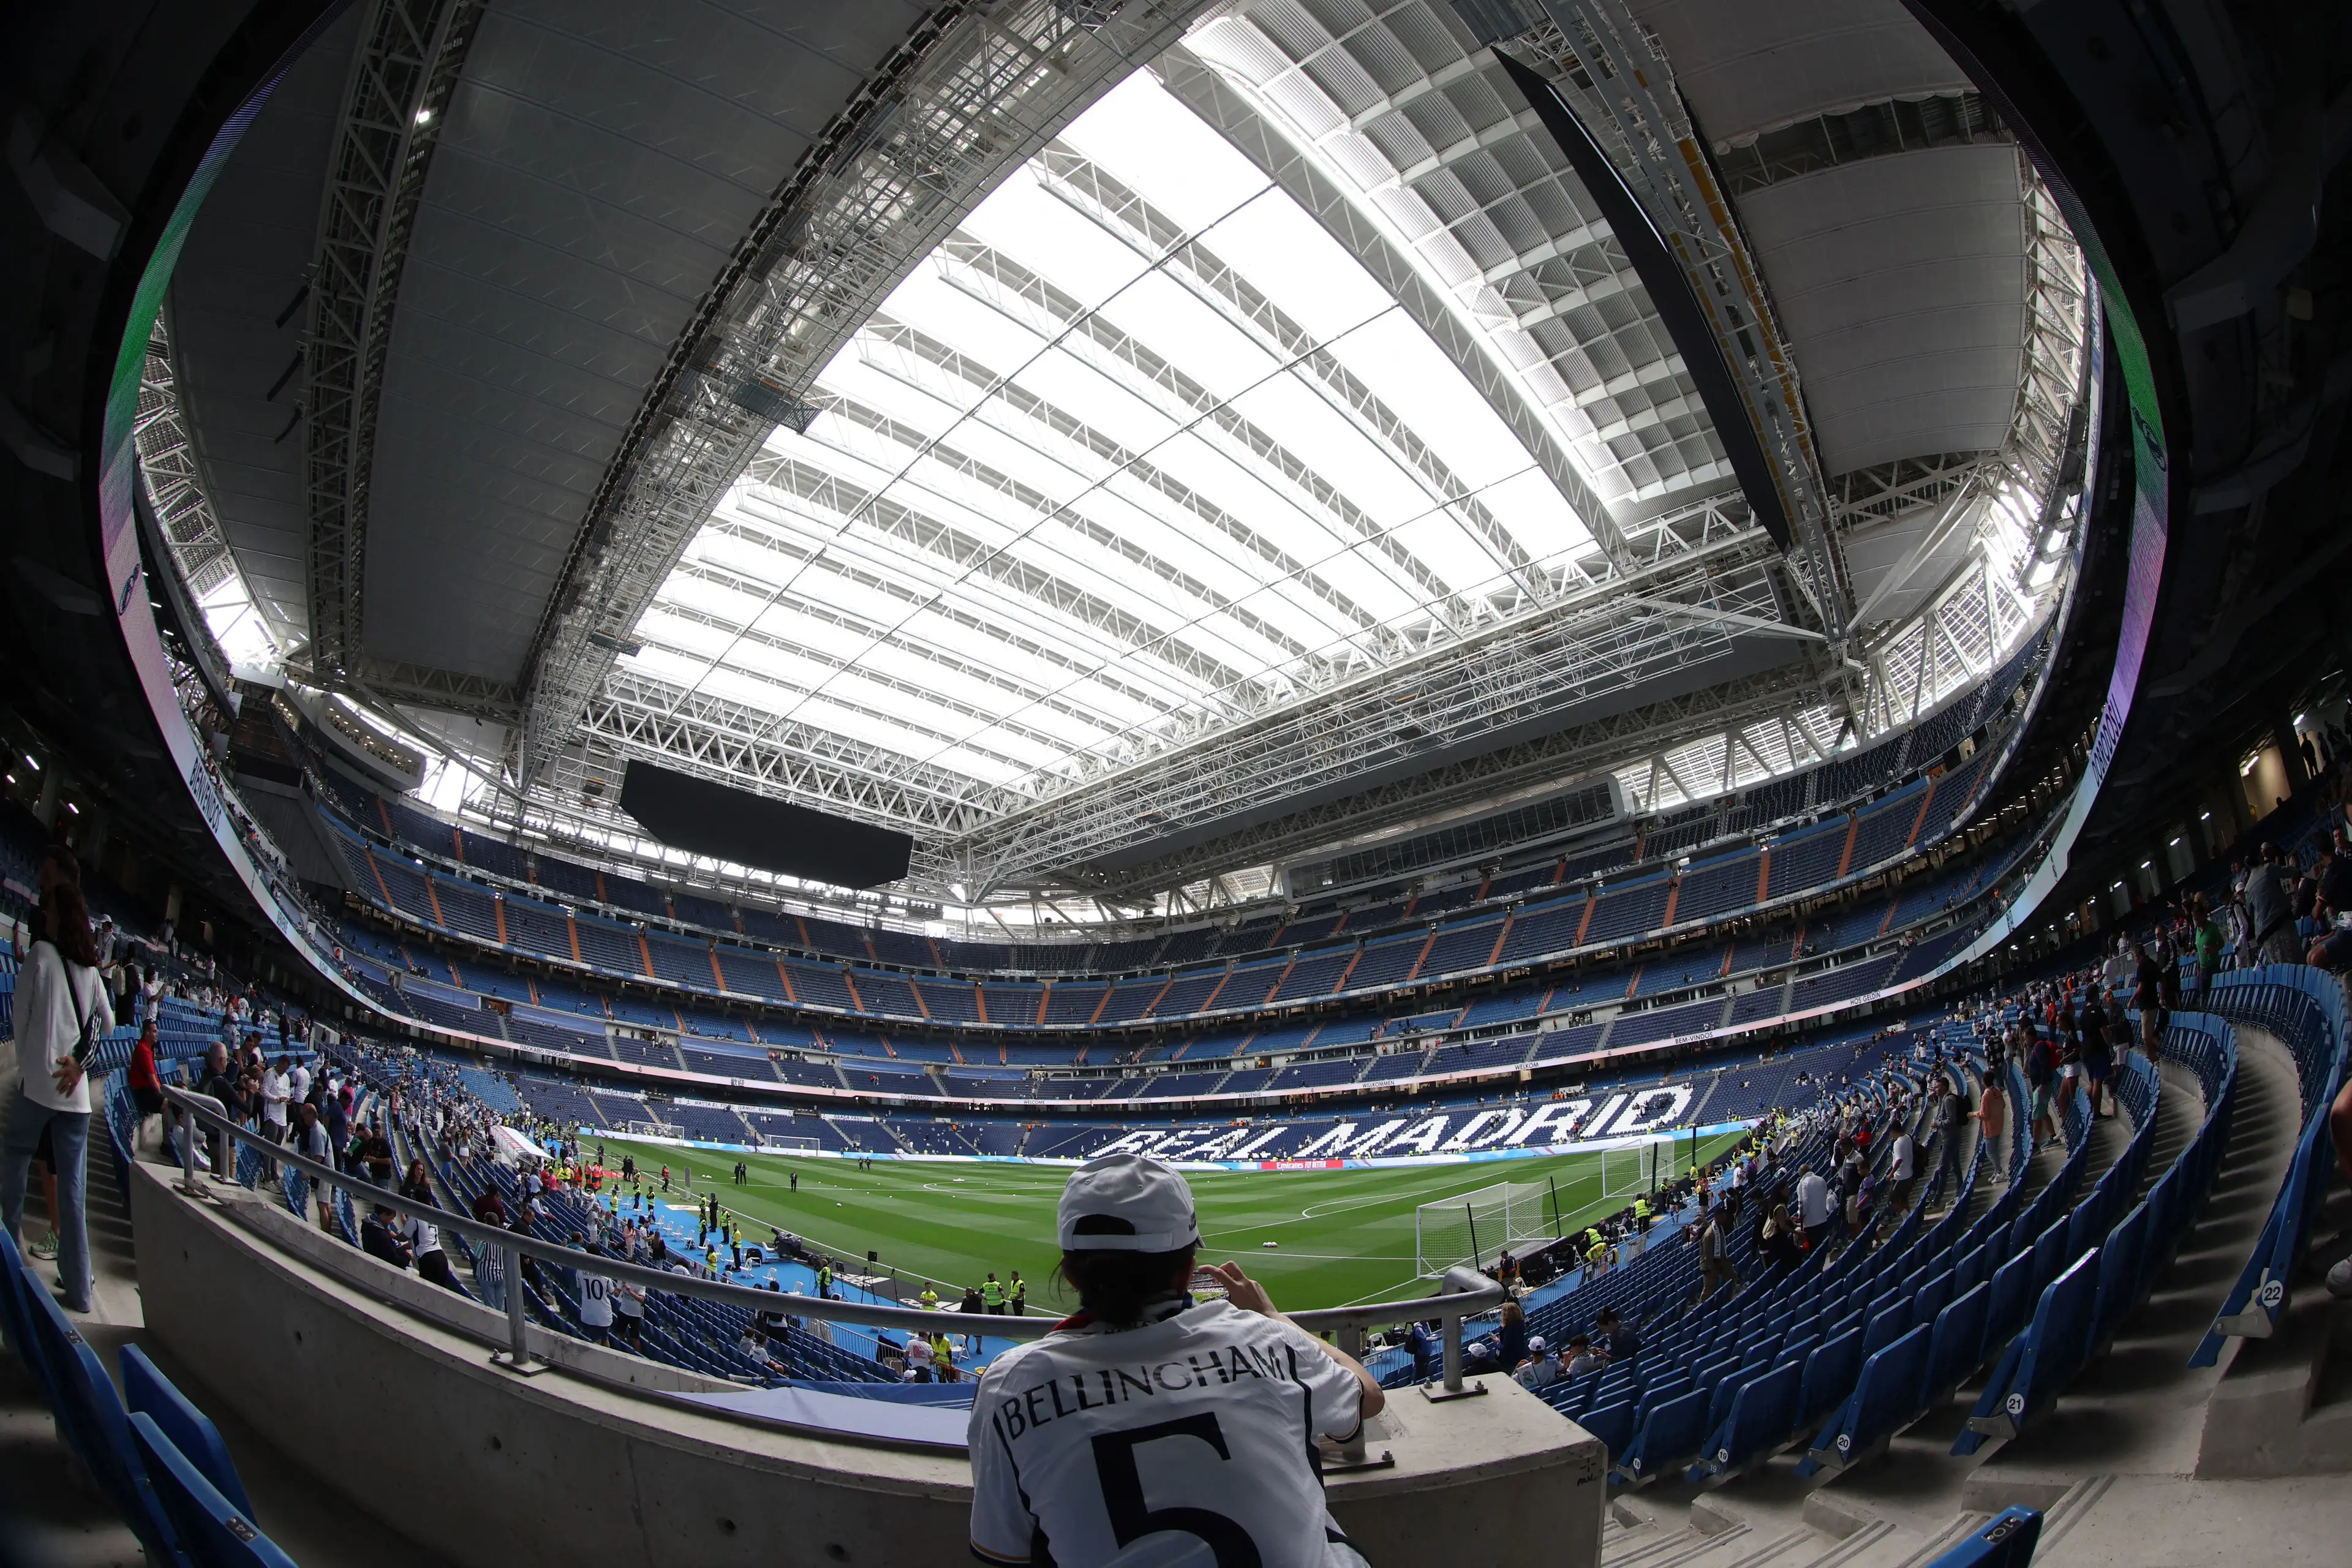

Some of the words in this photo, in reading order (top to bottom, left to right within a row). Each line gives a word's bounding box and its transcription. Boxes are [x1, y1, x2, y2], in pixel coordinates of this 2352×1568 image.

[190, 756, 222, 833] BIENVENIDOS
[1924, 838, 1933, 846] Real
[1932, 831, 1944, 842] Madrid
[1891, 854, 1905, 865] Madrid
[1841, 873, 1857, 884] Madrid
[1784, 893, 1803, 903] Madrid
[1728, 908, 1744, 917] Madrid
[1673, 922, 1691, 932] Madrid
[1675, 1031, 1714, 1045] BEM-VINDOS
[519, 1045, 545, 1054] ЛАСКАВО
[545, 1049, 570, 1058] ПРОСИМО
[1515, 1062, 1539, 1071] WELKOM
[1087, 1127, 1288, 1159] REAL
[1297, 1085, 1695, 1157] MADRID
[583, 1278, 604, 1300] 10
[2264, 1286, 2281, 1301] 22
[1001, 1345, 1286, 1441] BELLINGHAM
[2008, 1399, 2021, 1409] 21
[1838, 1438, 1850, 1448] 20
[1719, 1452, 1727, 1460] 19
[1710, 1464, 1717, 1472] 19
[1090, 1411, 1263, 1568] 5
